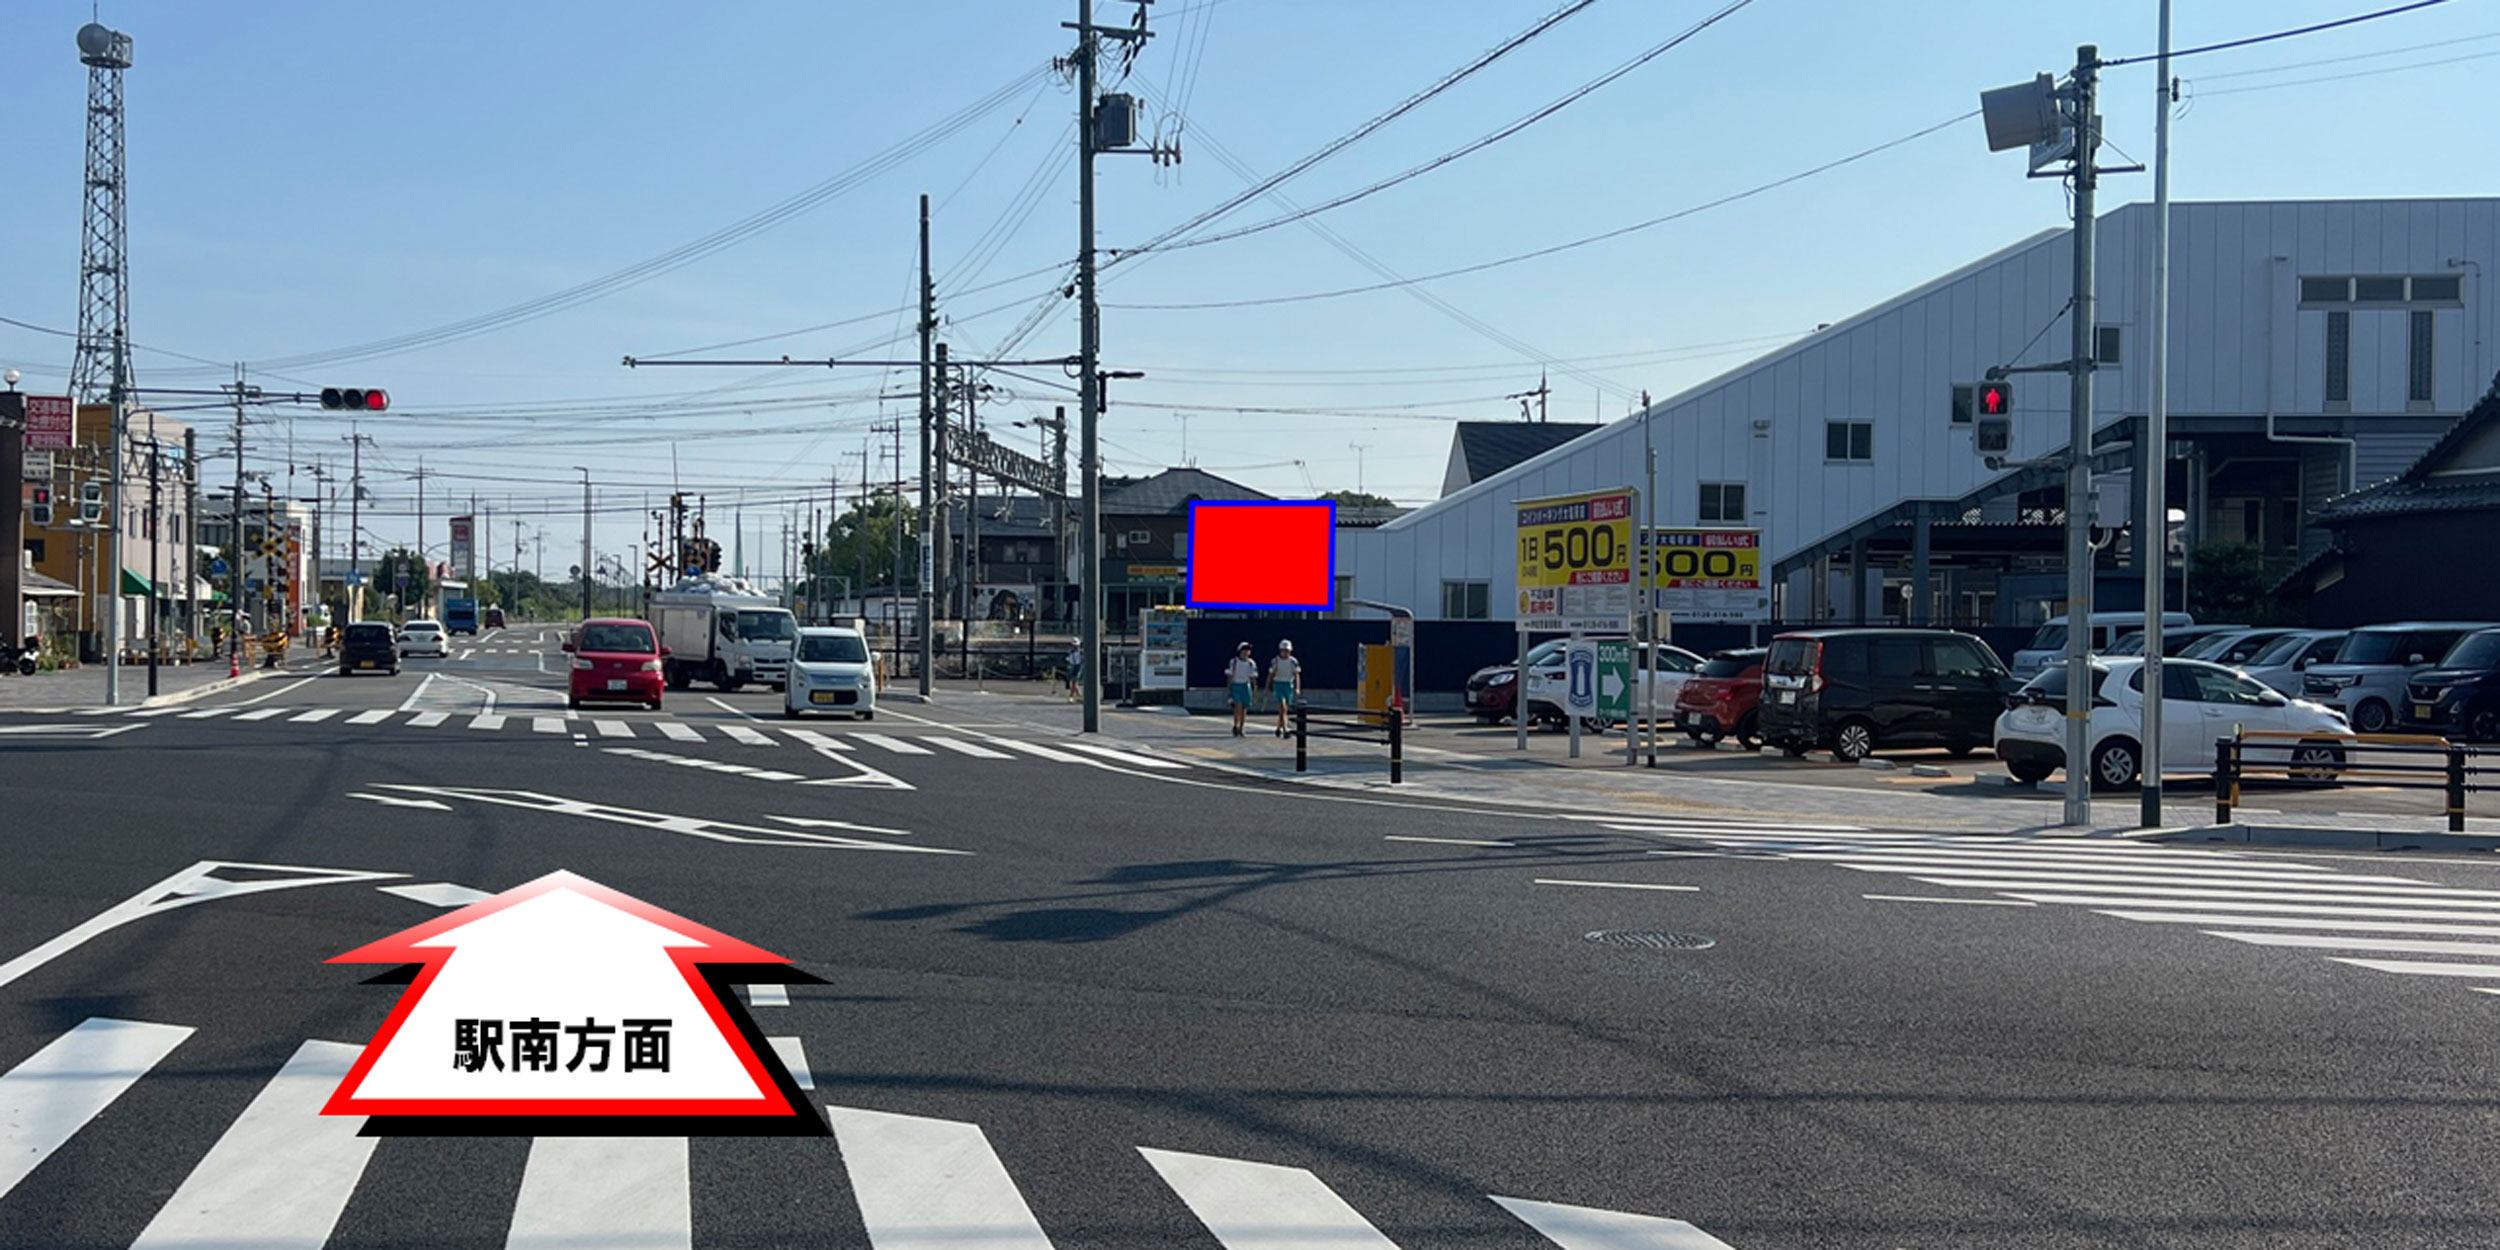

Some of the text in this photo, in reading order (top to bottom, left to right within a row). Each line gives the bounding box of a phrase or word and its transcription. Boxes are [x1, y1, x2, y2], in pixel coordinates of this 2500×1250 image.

[1521, 524, 1627, 570] 1日 500円
[1705, 534, 1750, 546] 前払い式
